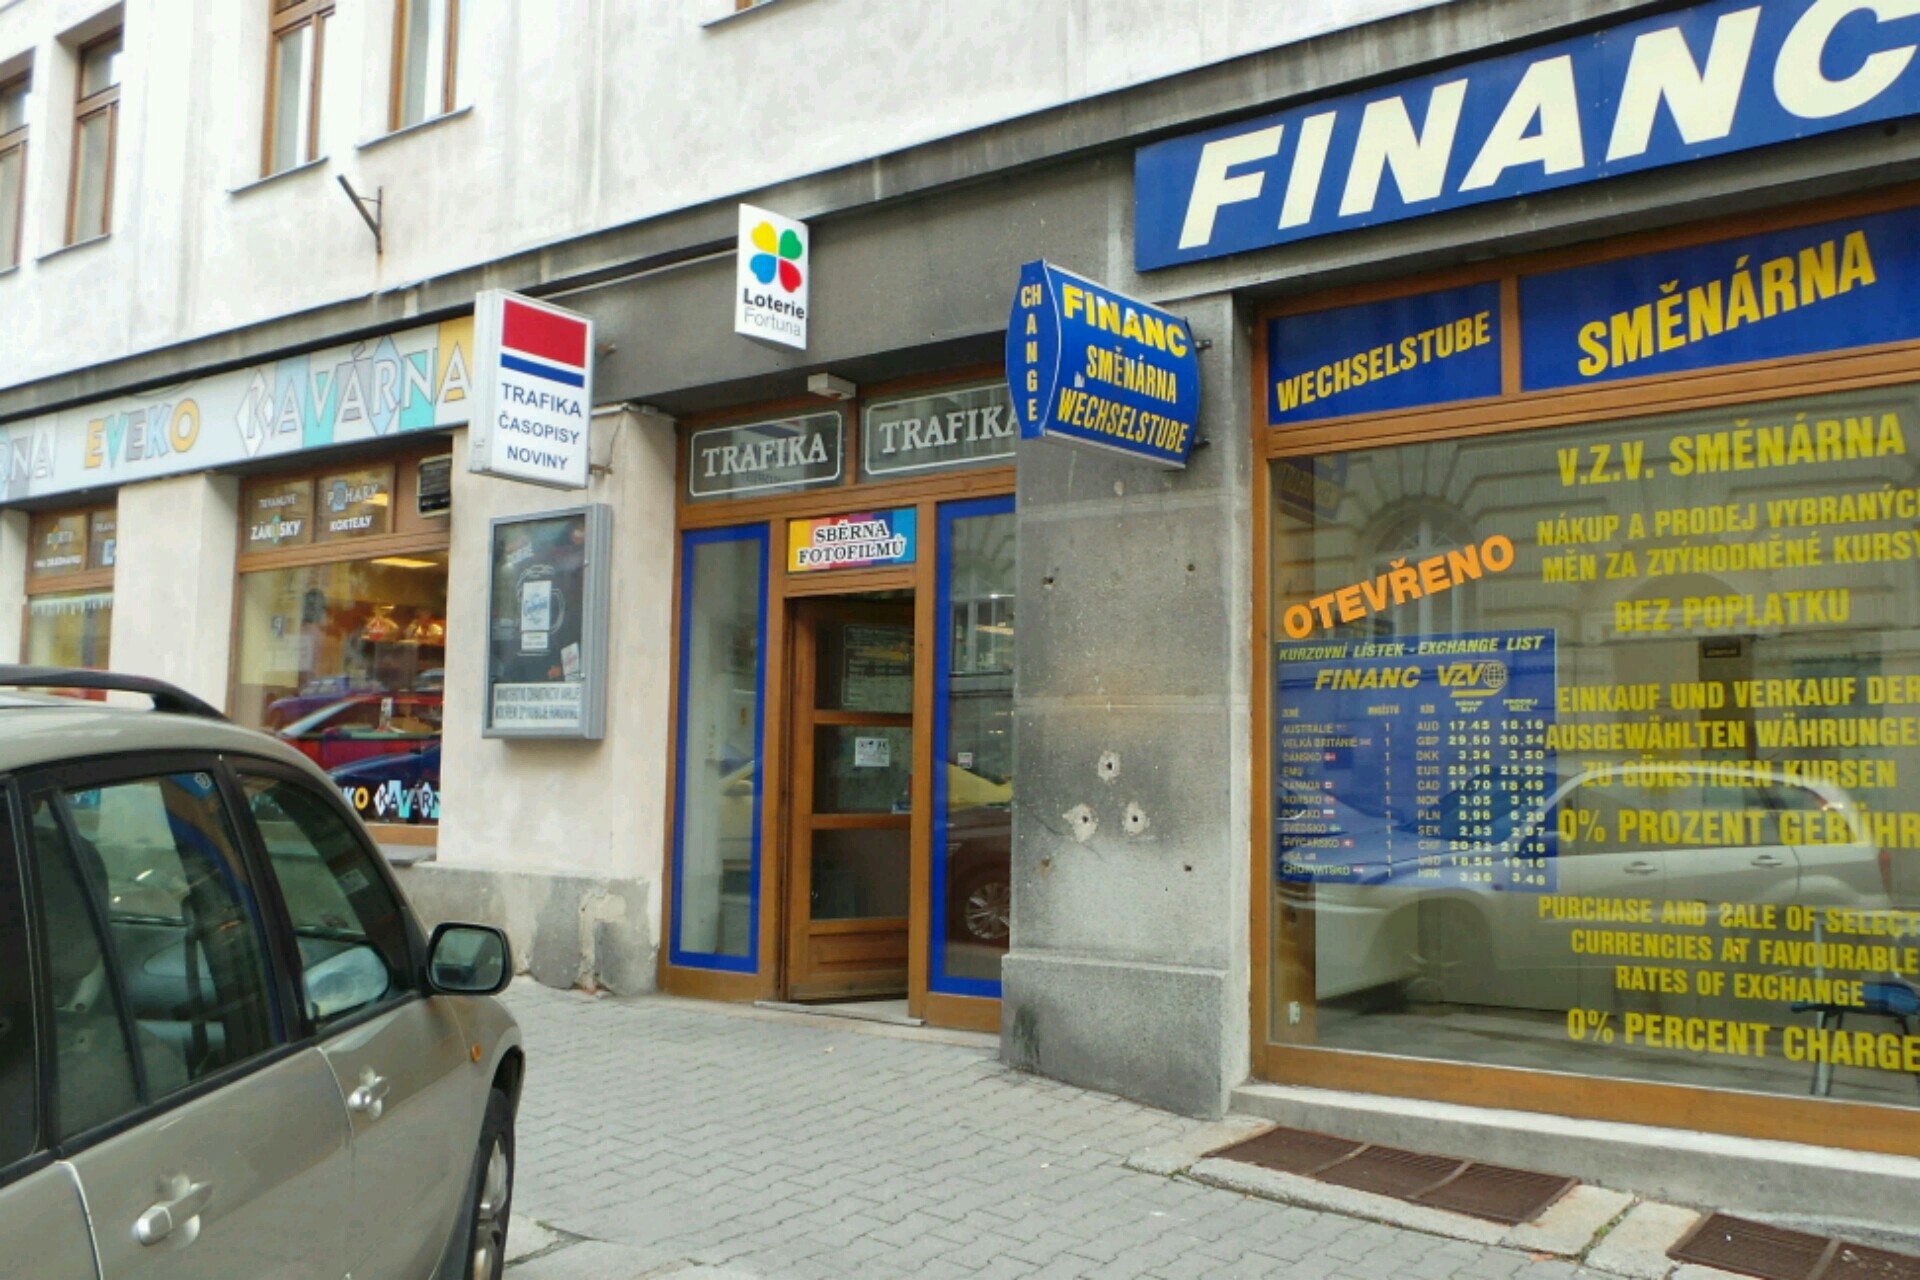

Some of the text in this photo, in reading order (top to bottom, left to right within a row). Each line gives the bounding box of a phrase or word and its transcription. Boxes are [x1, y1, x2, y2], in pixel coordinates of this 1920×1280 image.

[1178, 0, 1920, 250] FINANC
[743, 288, 805, 319] Loterie
[744, 308, 801, 337] Fortuna
[1062, 282, 1188, 358] FINANC
[1577, 230, 1877, 377] SMĚNÁRNA
[1086, 345, 1177, 404] SMĚNÁRNA
[1276, 310, 1492, 412] WECHSELSTUBE
[85, 398, 201, 470] EVEKO
[235, 338, 472, 458] KAVÁRNA
[501, 383, 582, 418] TRAFIKA
[1057, 387, 1190, 453] WECHSELSTUBE
[499, 414, 580, 445] ČASOPISY
[878, 403, 1020, 453] TRAFIKA
[507, 445, 568, 471] NOVINY
[702, 433, 828, 478] TRAFIKA
[1557, 413, 1906, 487] V.Z.V. SMĚNÁRNA
[815, 522, 888, 544] SBĚRNA
[1537, 483, 1920, 546] NÁKUP A PRODEJ VYBRANÝC
[798, 540, 905, 564] FOTOFILMŮ
[1542, 549, 1596, 583] MĚN
[1606, 549, 1637, 578] ZA
[1647, 533, 1822, 575] ZVÝHODNĚNÉ
[1283, 534, 1515, 640] OTEVŘENO
[1615, 588, 1852, 633] BEZ POPLATKU
[1279, 641, 1348, 661] KURZOVNÍ
[1353, 641, 1405, 658] LÍSTEK
[1418, 641, 1499, 655] EXCHANGE
[1506, 635, 1546, 651] LIST
[1314, 662, 1485, 691] FINANC VZV
[1557, 682, 1661, 713] EINKAUF
[1670, 680, 1726, 709] UND
[1733, 676, 1857, 708] VERKAUF
[1416, 721, 1440, 731] AUD
[1449, 720, 1491, 731] 17.45
[1545, 713, 1920, 750] AUSGEWÄHLTEN WÄHRUNGE
[1508, 749, 1544, 761] 3.50
[1581, 754, 1896, 788] ZU GÜNSTIGEN KURSEN
[1450, 780, 1491, 791] 17.70
[1417, 811, 1440, 821] PLN
[1417, 826, 1440, 836] SEK
[1559, 800, 1920, 848] 0% PROZENT GEBÜHR
[1539, 896, 1652, 924] PURCHASE
[1661, 902, 1706, 926] AND
[1786, 907, 1816, 932] OF
[1571, 930, 1918, 975] CURRENCIES AT FAVOURABLE
[1616, 965, 1865, 1006] RATES OF EXCHANGE
[1566, 1008, 1920, 1072] 0% PERCENT CHARGE
